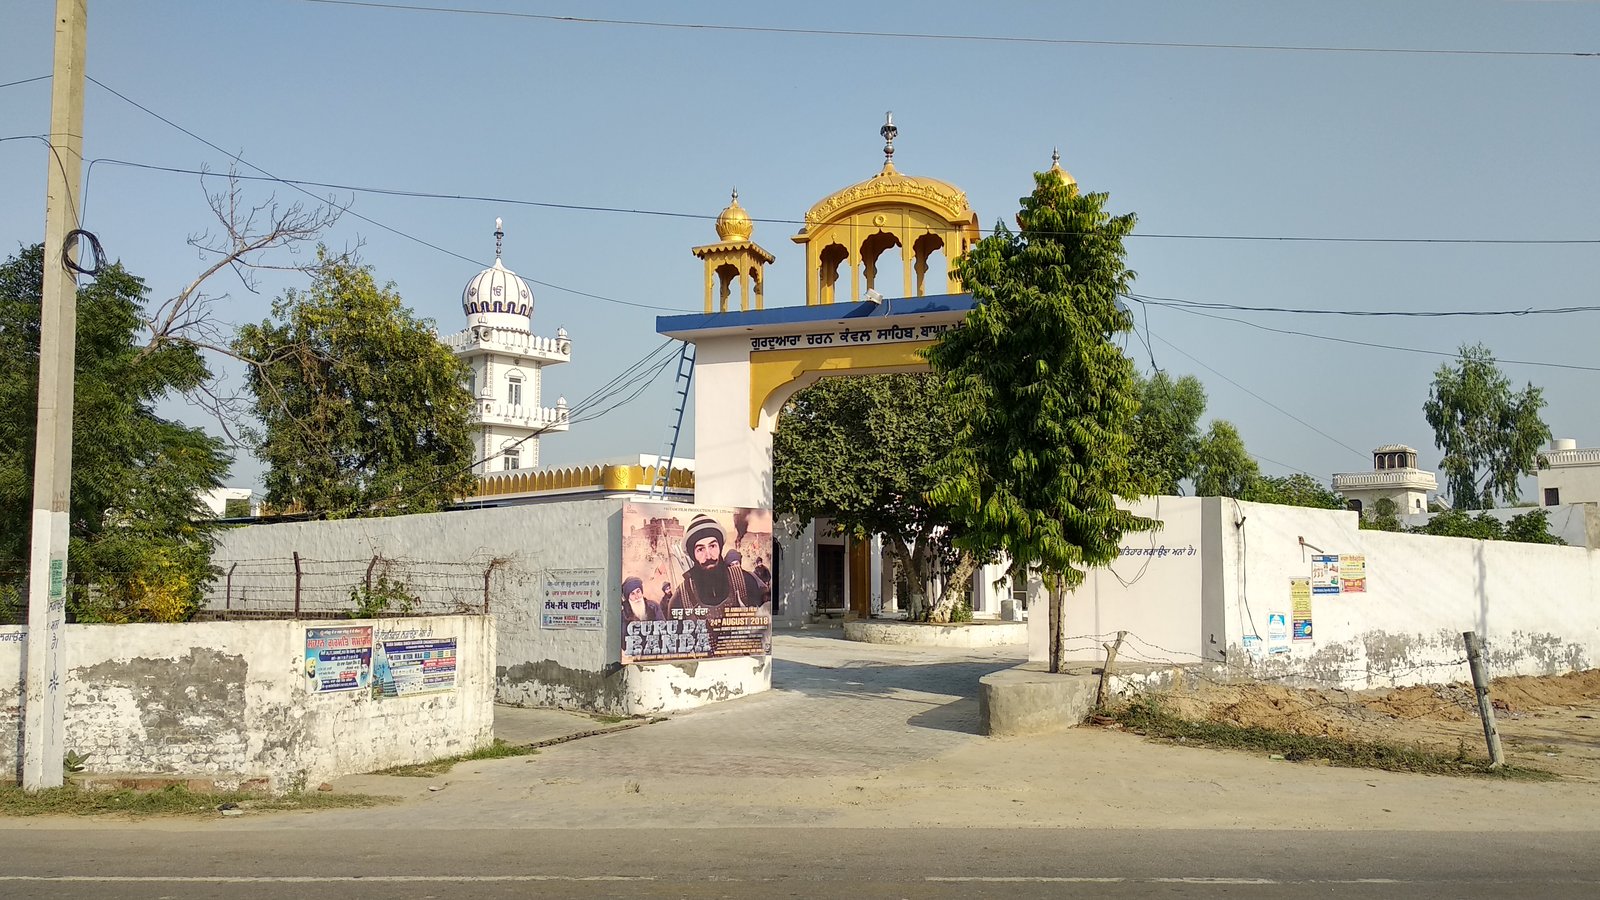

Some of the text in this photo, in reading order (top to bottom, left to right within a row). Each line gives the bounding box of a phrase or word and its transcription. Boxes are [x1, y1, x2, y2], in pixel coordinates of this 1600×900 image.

[751, 335, 801, 350] ਗੁਰਦੁਆਰਾ
[806, 333, 834, 345] ਚਰਨ
[839, 328, 872, 343] ਕੰਵਲ
[685, 608, 693, 616] ਦਾ
[694, 605, 708, 616] ਬੰਦਾ
[627, 620, 708, 637] GURU DA
[722, 617, 748, 626] AUGUST
[750, 617, 768, 625] 2018
[625, 634, 711, 655] BANDA
